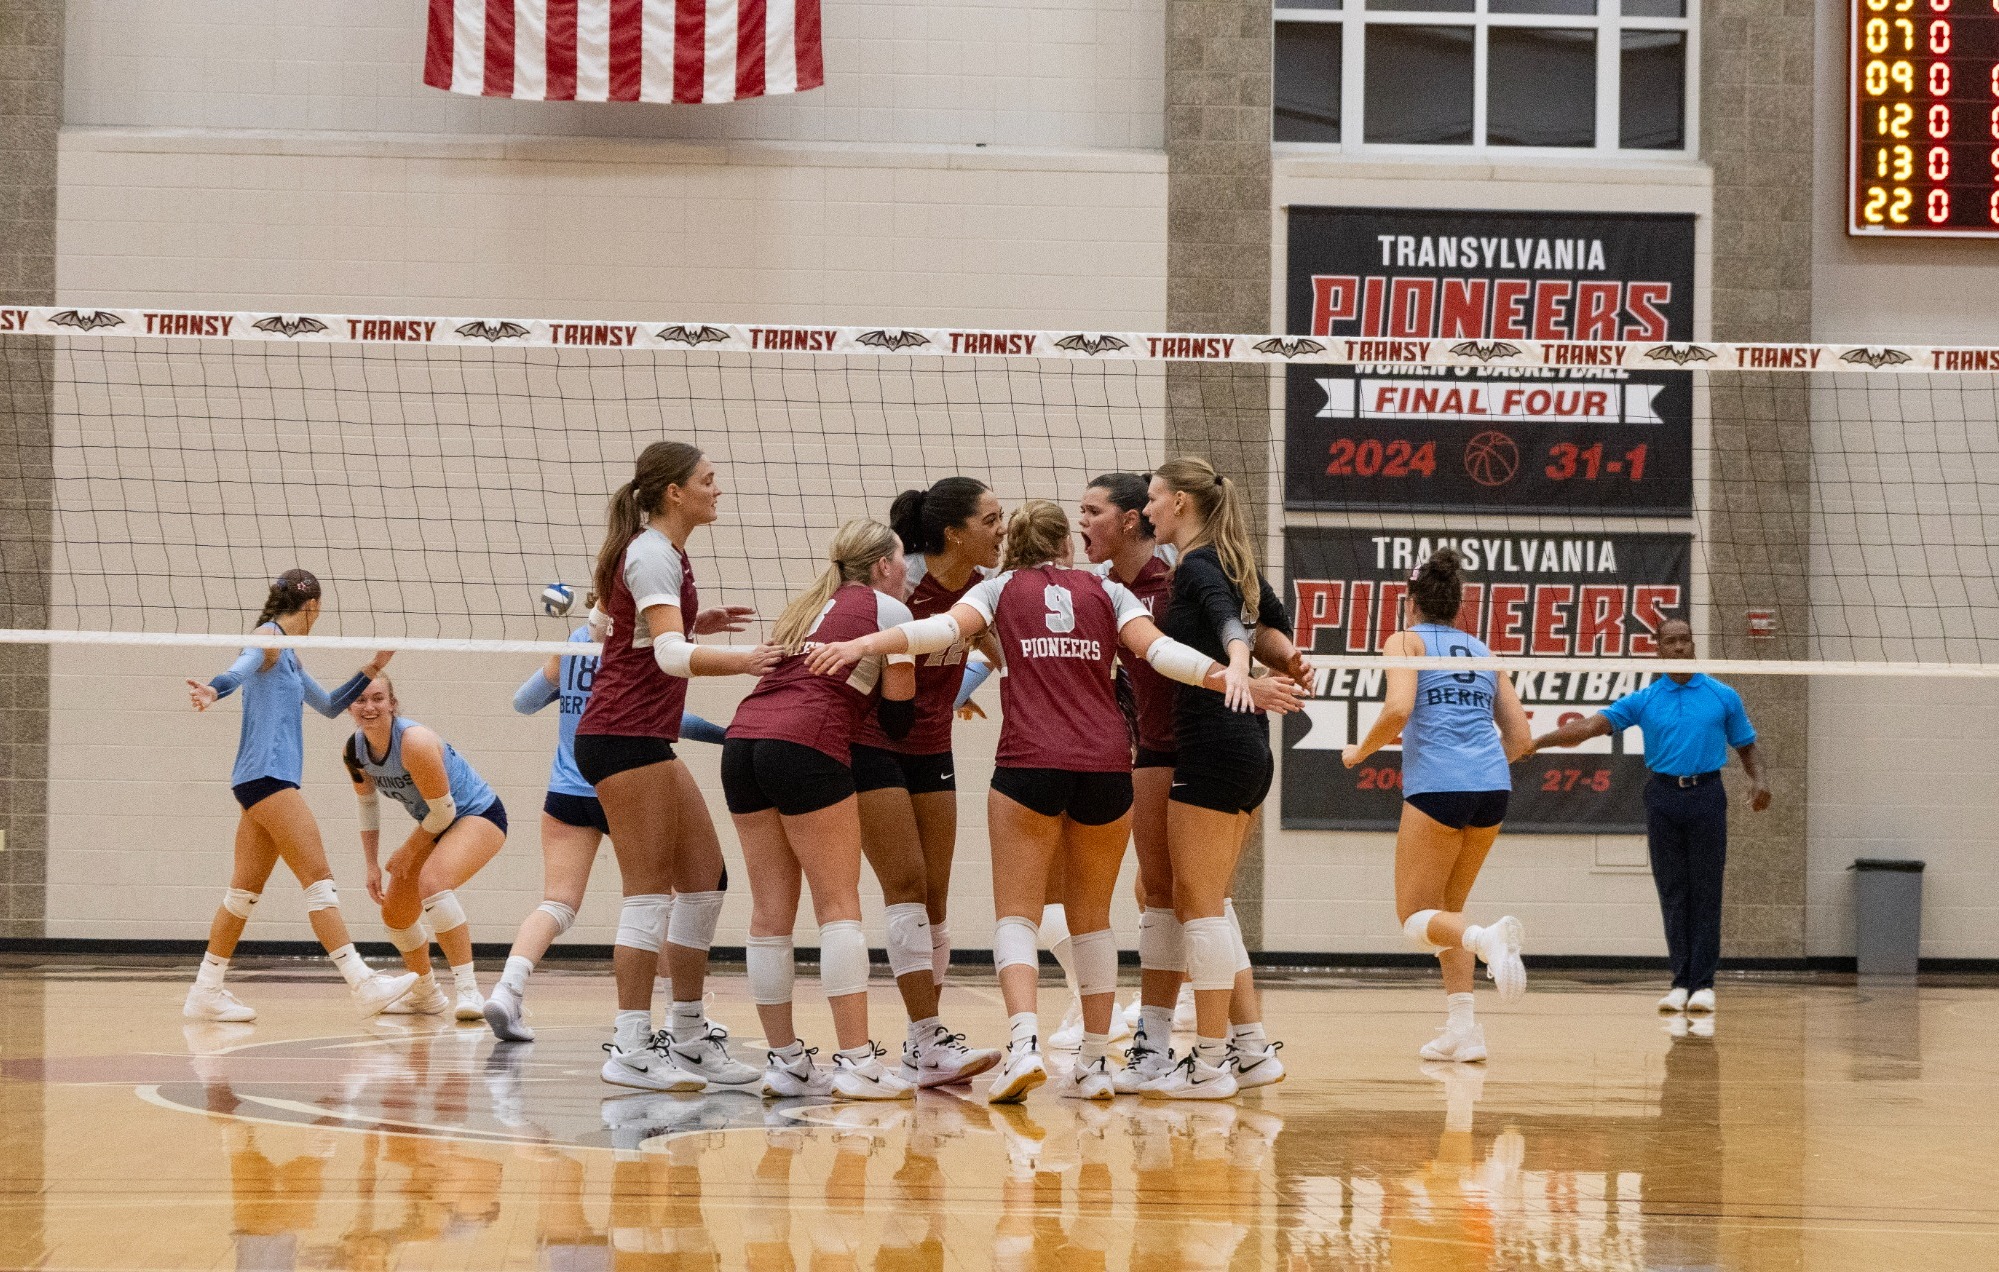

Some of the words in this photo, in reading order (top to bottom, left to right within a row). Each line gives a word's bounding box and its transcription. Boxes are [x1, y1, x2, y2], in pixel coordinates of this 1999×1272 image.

[1866, 18, 1913, 53] 07
[1930, 20, 1950, 54] 0
[1865, 60, 1913, 95] 09
[1930, 62, 1949, 96] 0
[1878, 103, 1913, 138] 12
[1929, 105, 1949, 139] 0
[1877, 145, 1913, 180] 13
[1928, 147, 1948, 181] 0
[1864, 187, 1913, 222] 22
[1928, 189, 1948, 223] 0
[1378, 235, 1606, 271] TRANSYLVANIA
[1310, 275, 1672, 342] PIONEERS
[144, 314, 233, 336] TRANSY
[347, 319, 436, 341] TRANSY
[550, 324, 637, 346] TRANSY
[749, 329, 837, 351] TRANSY
[949, 332, 1036, 354] TRANSY
[1147, 337, 1235, 359] TRANSY
[1345, 341, 1430, 362] TRANSY
[1541, 344, 1626, 365] TRANSY
[1735, 347, 1821, 368] TRANSY
[1931, 350, 1999, 370] TRANS
[1374, 386, 1487, 414] FINAL
[1501, 389, 1608, 416] FOUR
[1326, 438, 1437, 477] 2024
[1545, 443, 1648, 481] 31-1
[1044, 584, 1075, 633] 9
[1020, 637, 1101, 660] PIONEERS
[1426, 687, 1493, 710] BERRY
[1541, 768, 1611, 792] 27-5
